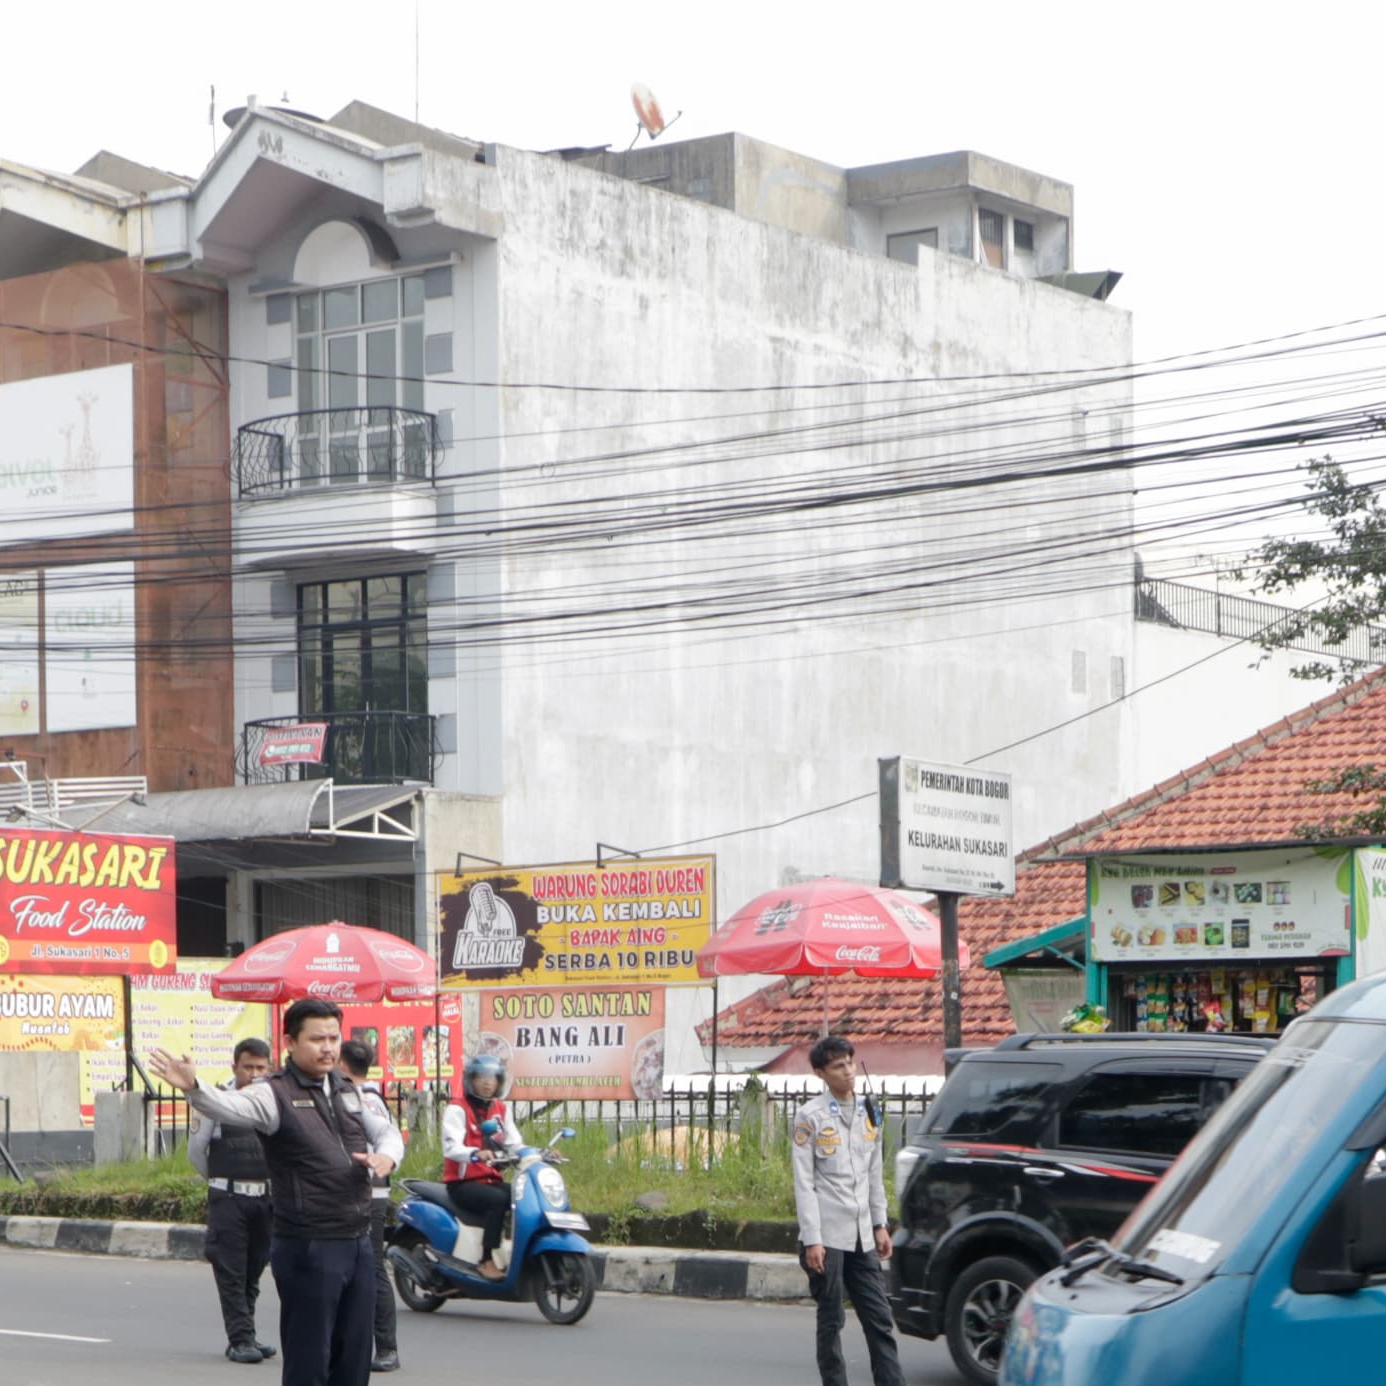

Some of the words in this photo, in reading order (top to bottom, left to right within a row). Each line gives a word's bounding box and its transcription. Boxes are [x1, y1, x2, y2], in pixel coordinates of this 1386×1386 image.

[921, 770, 965, 794] PEMERINTAH
[966, 777, 984, 797] KOTA
[984, 780, 1010, 800] BOGOR
[908, 829, 962, 853] KELURAHAN
[963, 838, 1009, 858] SUKASARI
[532, 874, 597, 899] WARUNG
[601, 871, 653, 896] SORABI
[656, 868, 705, 895] DUREN
[10, 895, 71, 933] Food
[68, 898, 146, 937] Station
[536, 904, 597, 924] BUKA
[602, 900, 702, 921] KEMBALI
[492, 927, 512, 937] FREE
[569, 927, 621, 949] BAPAK
[626, 925, 667, 946] AING
[31, 944, 45, 957] Jl.
[47, 945, 92, 958] Sukasari
[123, 948, 130, 959] 5
[455, 931, 524, 967] KARAOKE
[544, 952, 611, 970] SERBA
[616, 952, 639, 969] 10
[643, 950, 695, 968] RIBU
[57, 993, 114, 1018] AYAM
[493, 994, 555, 1020] SOTO
[562, 991, 652, 1017] SANTAN
[516, 1026, 579, 1048] BANG
[587, 1024, 626, 1047] ALI
